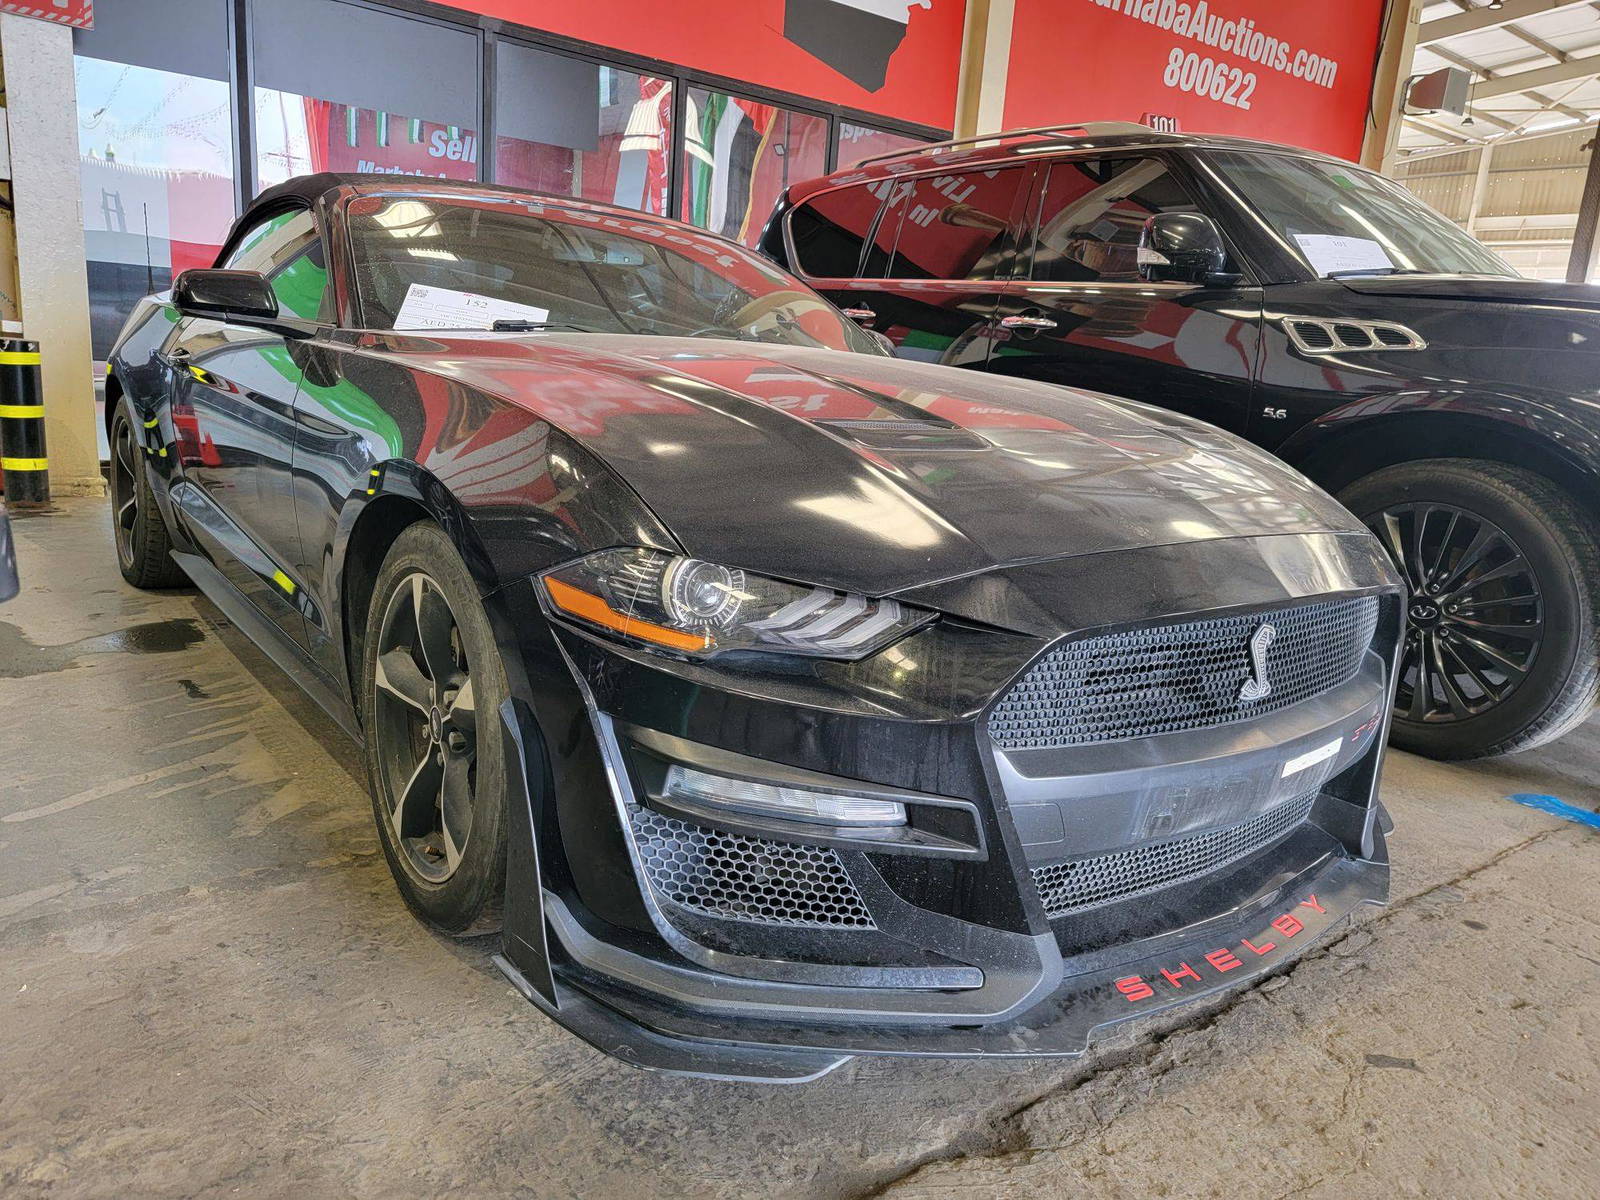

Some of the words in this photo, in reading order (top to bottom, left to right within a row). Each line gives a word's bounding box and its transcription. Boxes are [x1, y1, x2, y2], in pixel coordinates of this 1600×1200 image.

[1163, 47, 1257, 110] 800622
[428, 129, 477, 164] Sell
[1152, 115, 1175, 132] 101
[1113, 893, 1328, 1003] SHELBY
